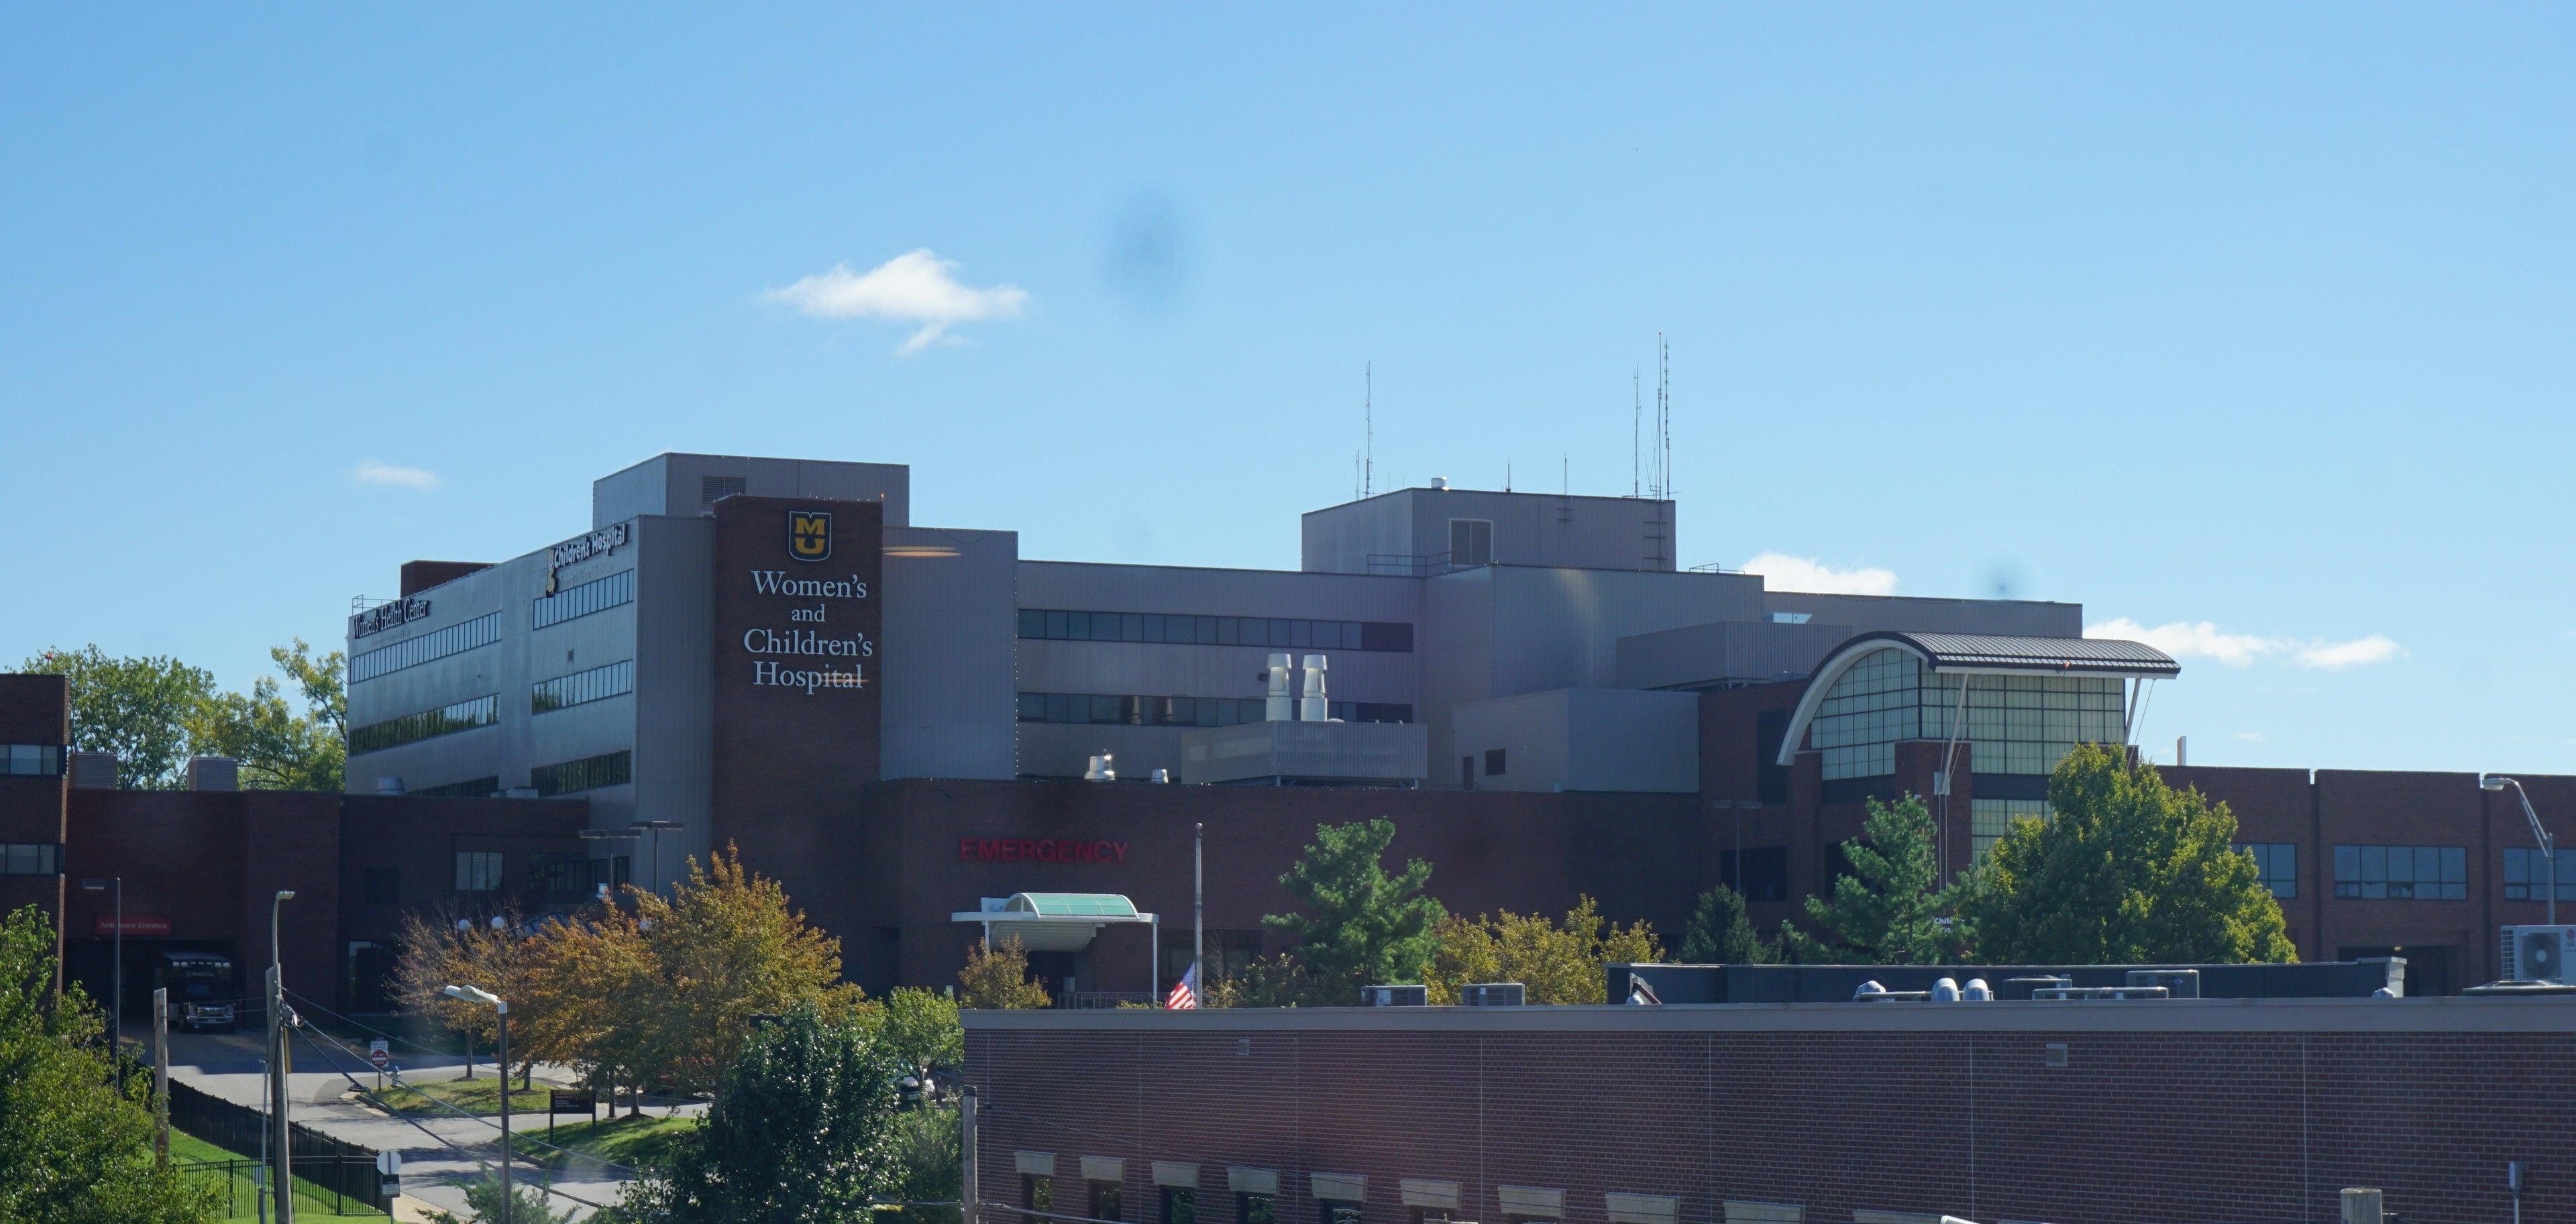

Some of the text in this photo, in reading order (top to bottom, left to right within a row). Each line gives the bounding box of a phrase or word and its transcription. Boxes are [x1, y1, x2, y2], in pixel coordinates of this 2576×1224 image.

[554, 523, 625, 568] Children's Hospital
[751, 570, 867, 598] Women's
[353, 608, 380, 640] Women's
[380, 600, 402, 630] Health
[404, 598, 427, 622] Center
[791, 604, 826, 622] and
[743, 628, 873, 657] Children's
[753, 661, 863, 696] Hospital
[959, 838, 1129, 864] EMERGENCY
